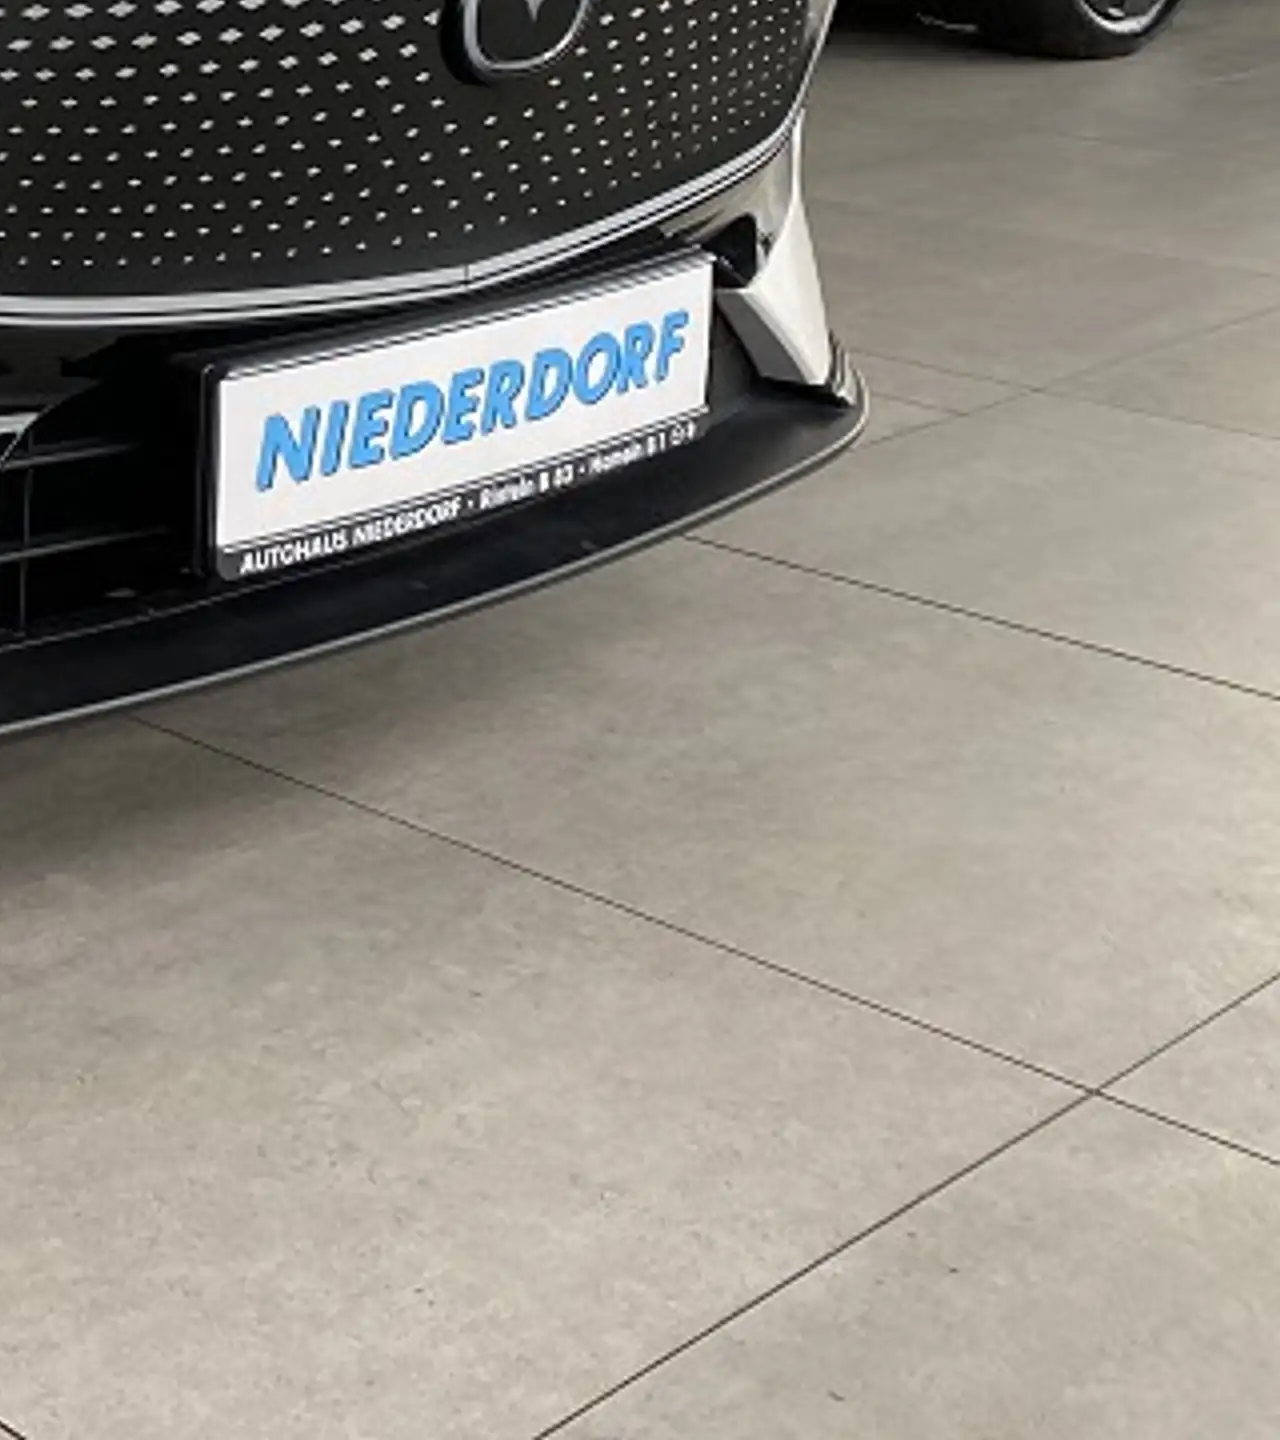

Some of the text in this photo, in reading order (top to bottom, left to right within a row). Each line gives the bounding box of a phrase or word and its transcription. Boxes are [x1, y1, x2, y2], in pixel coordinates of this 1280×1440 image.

[255, 309, 690, 492] NIEDERDORF
[240, 529, 349, 575] AUTOHAUS
[352, 496, 463, 544] NIEDERDORF
